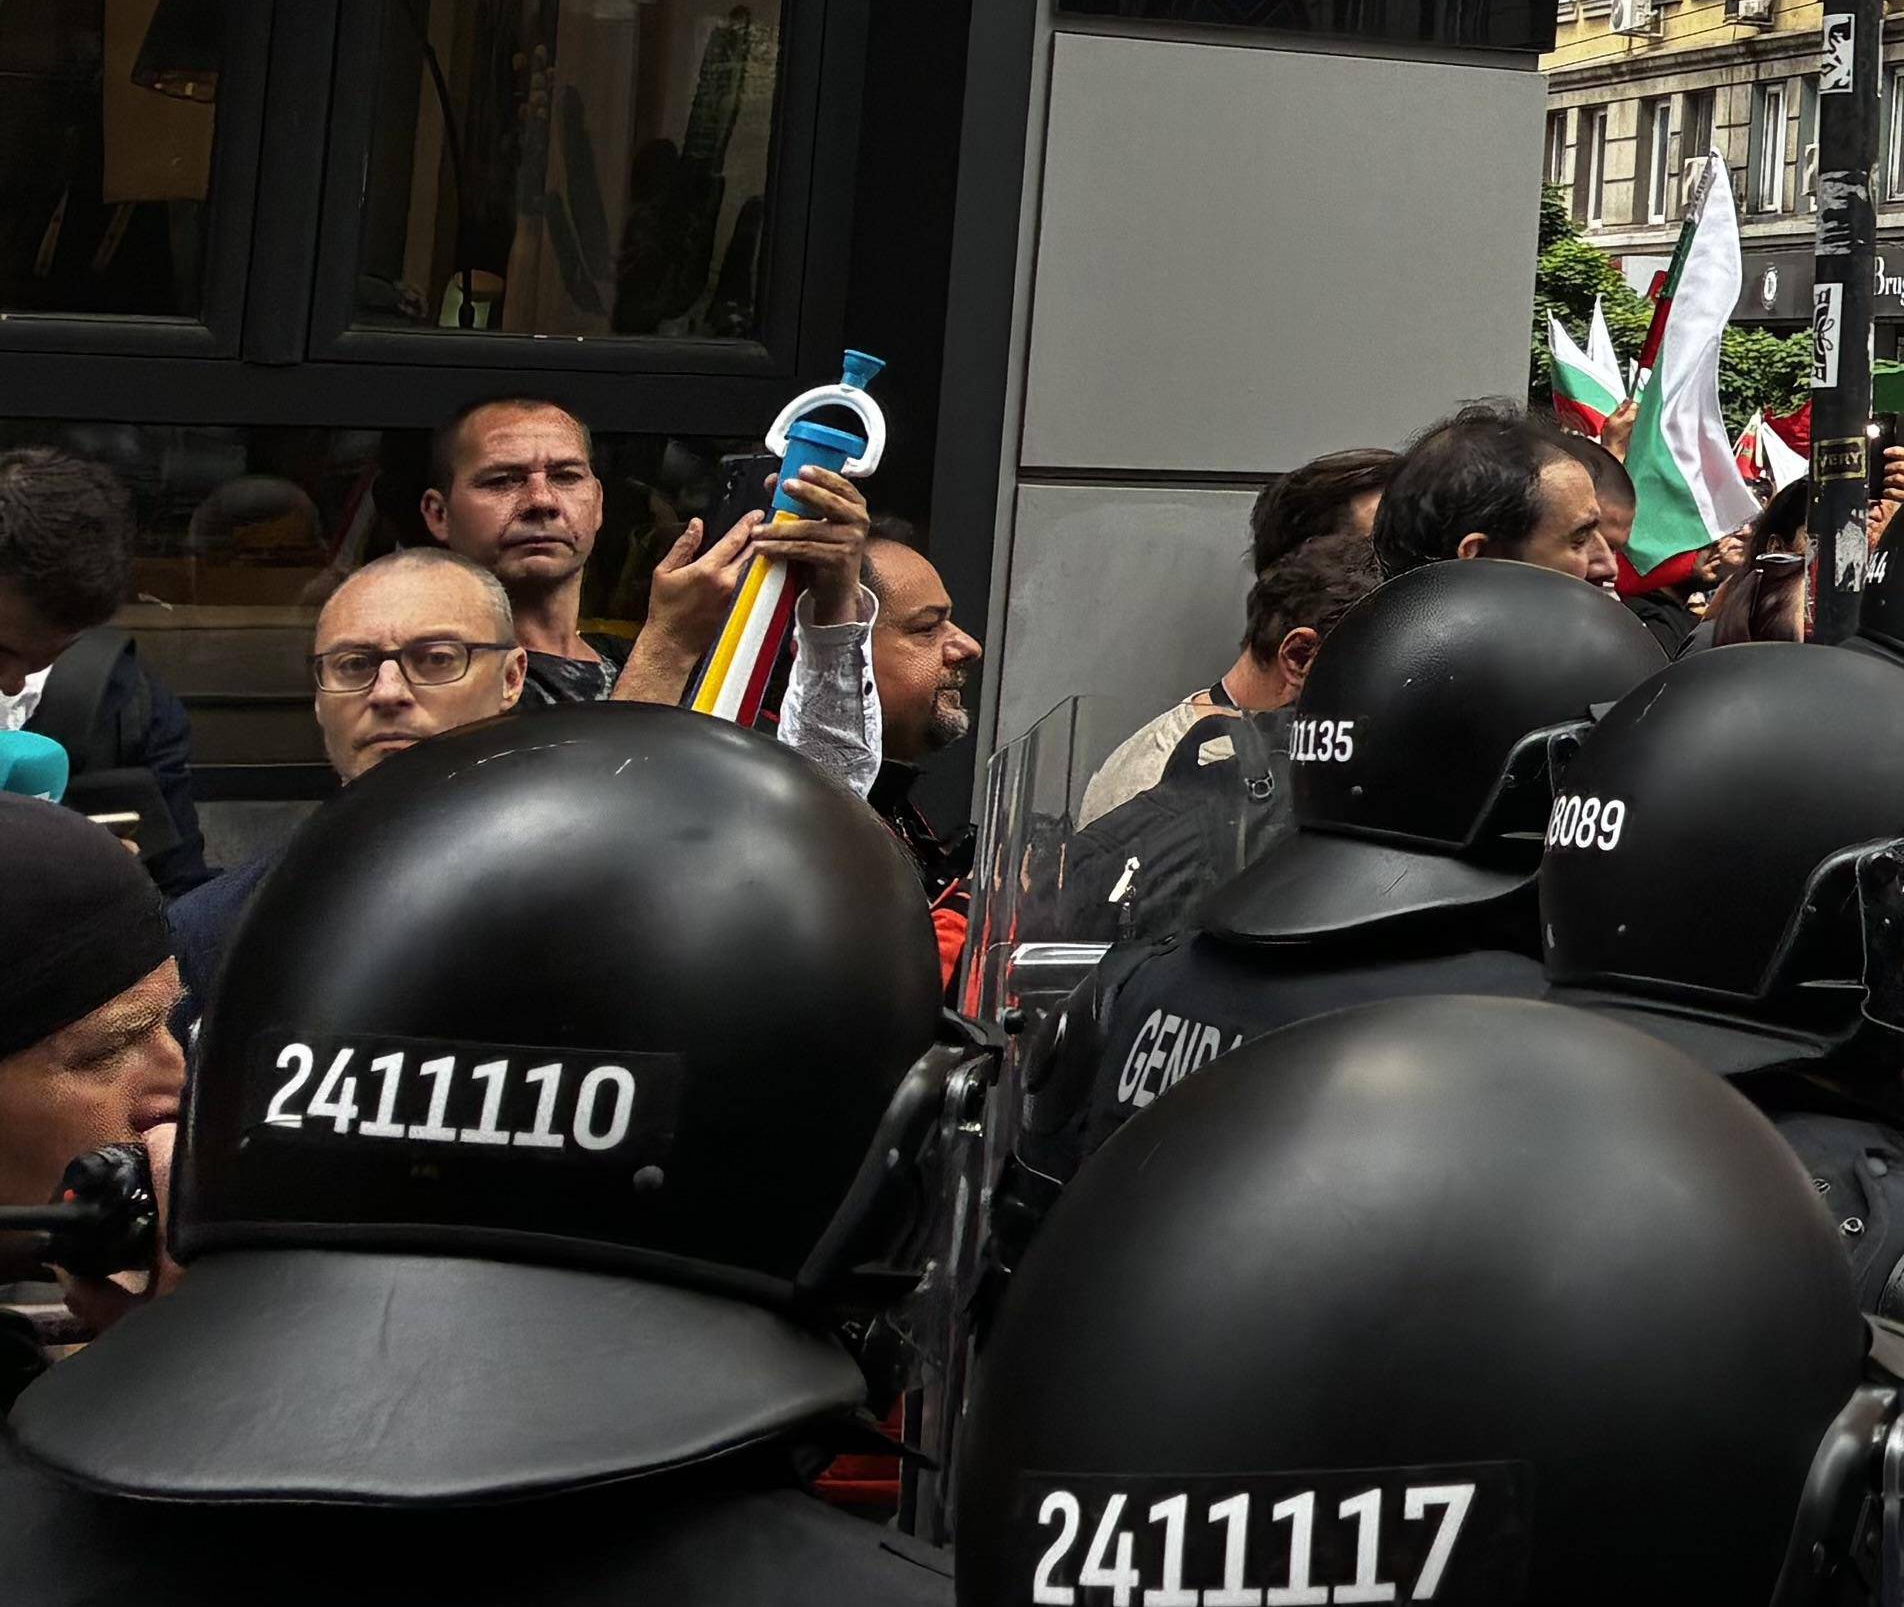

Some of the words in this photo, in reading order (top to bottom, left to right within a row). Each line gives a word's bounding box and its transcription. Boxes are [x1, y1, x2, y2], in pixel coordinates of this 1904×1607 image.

[265, 1043, 635, 1150] 2411110
[1118, 1009, 1243, 1108] GEND
[1033, 1483, 1476, 1607] 2411117
